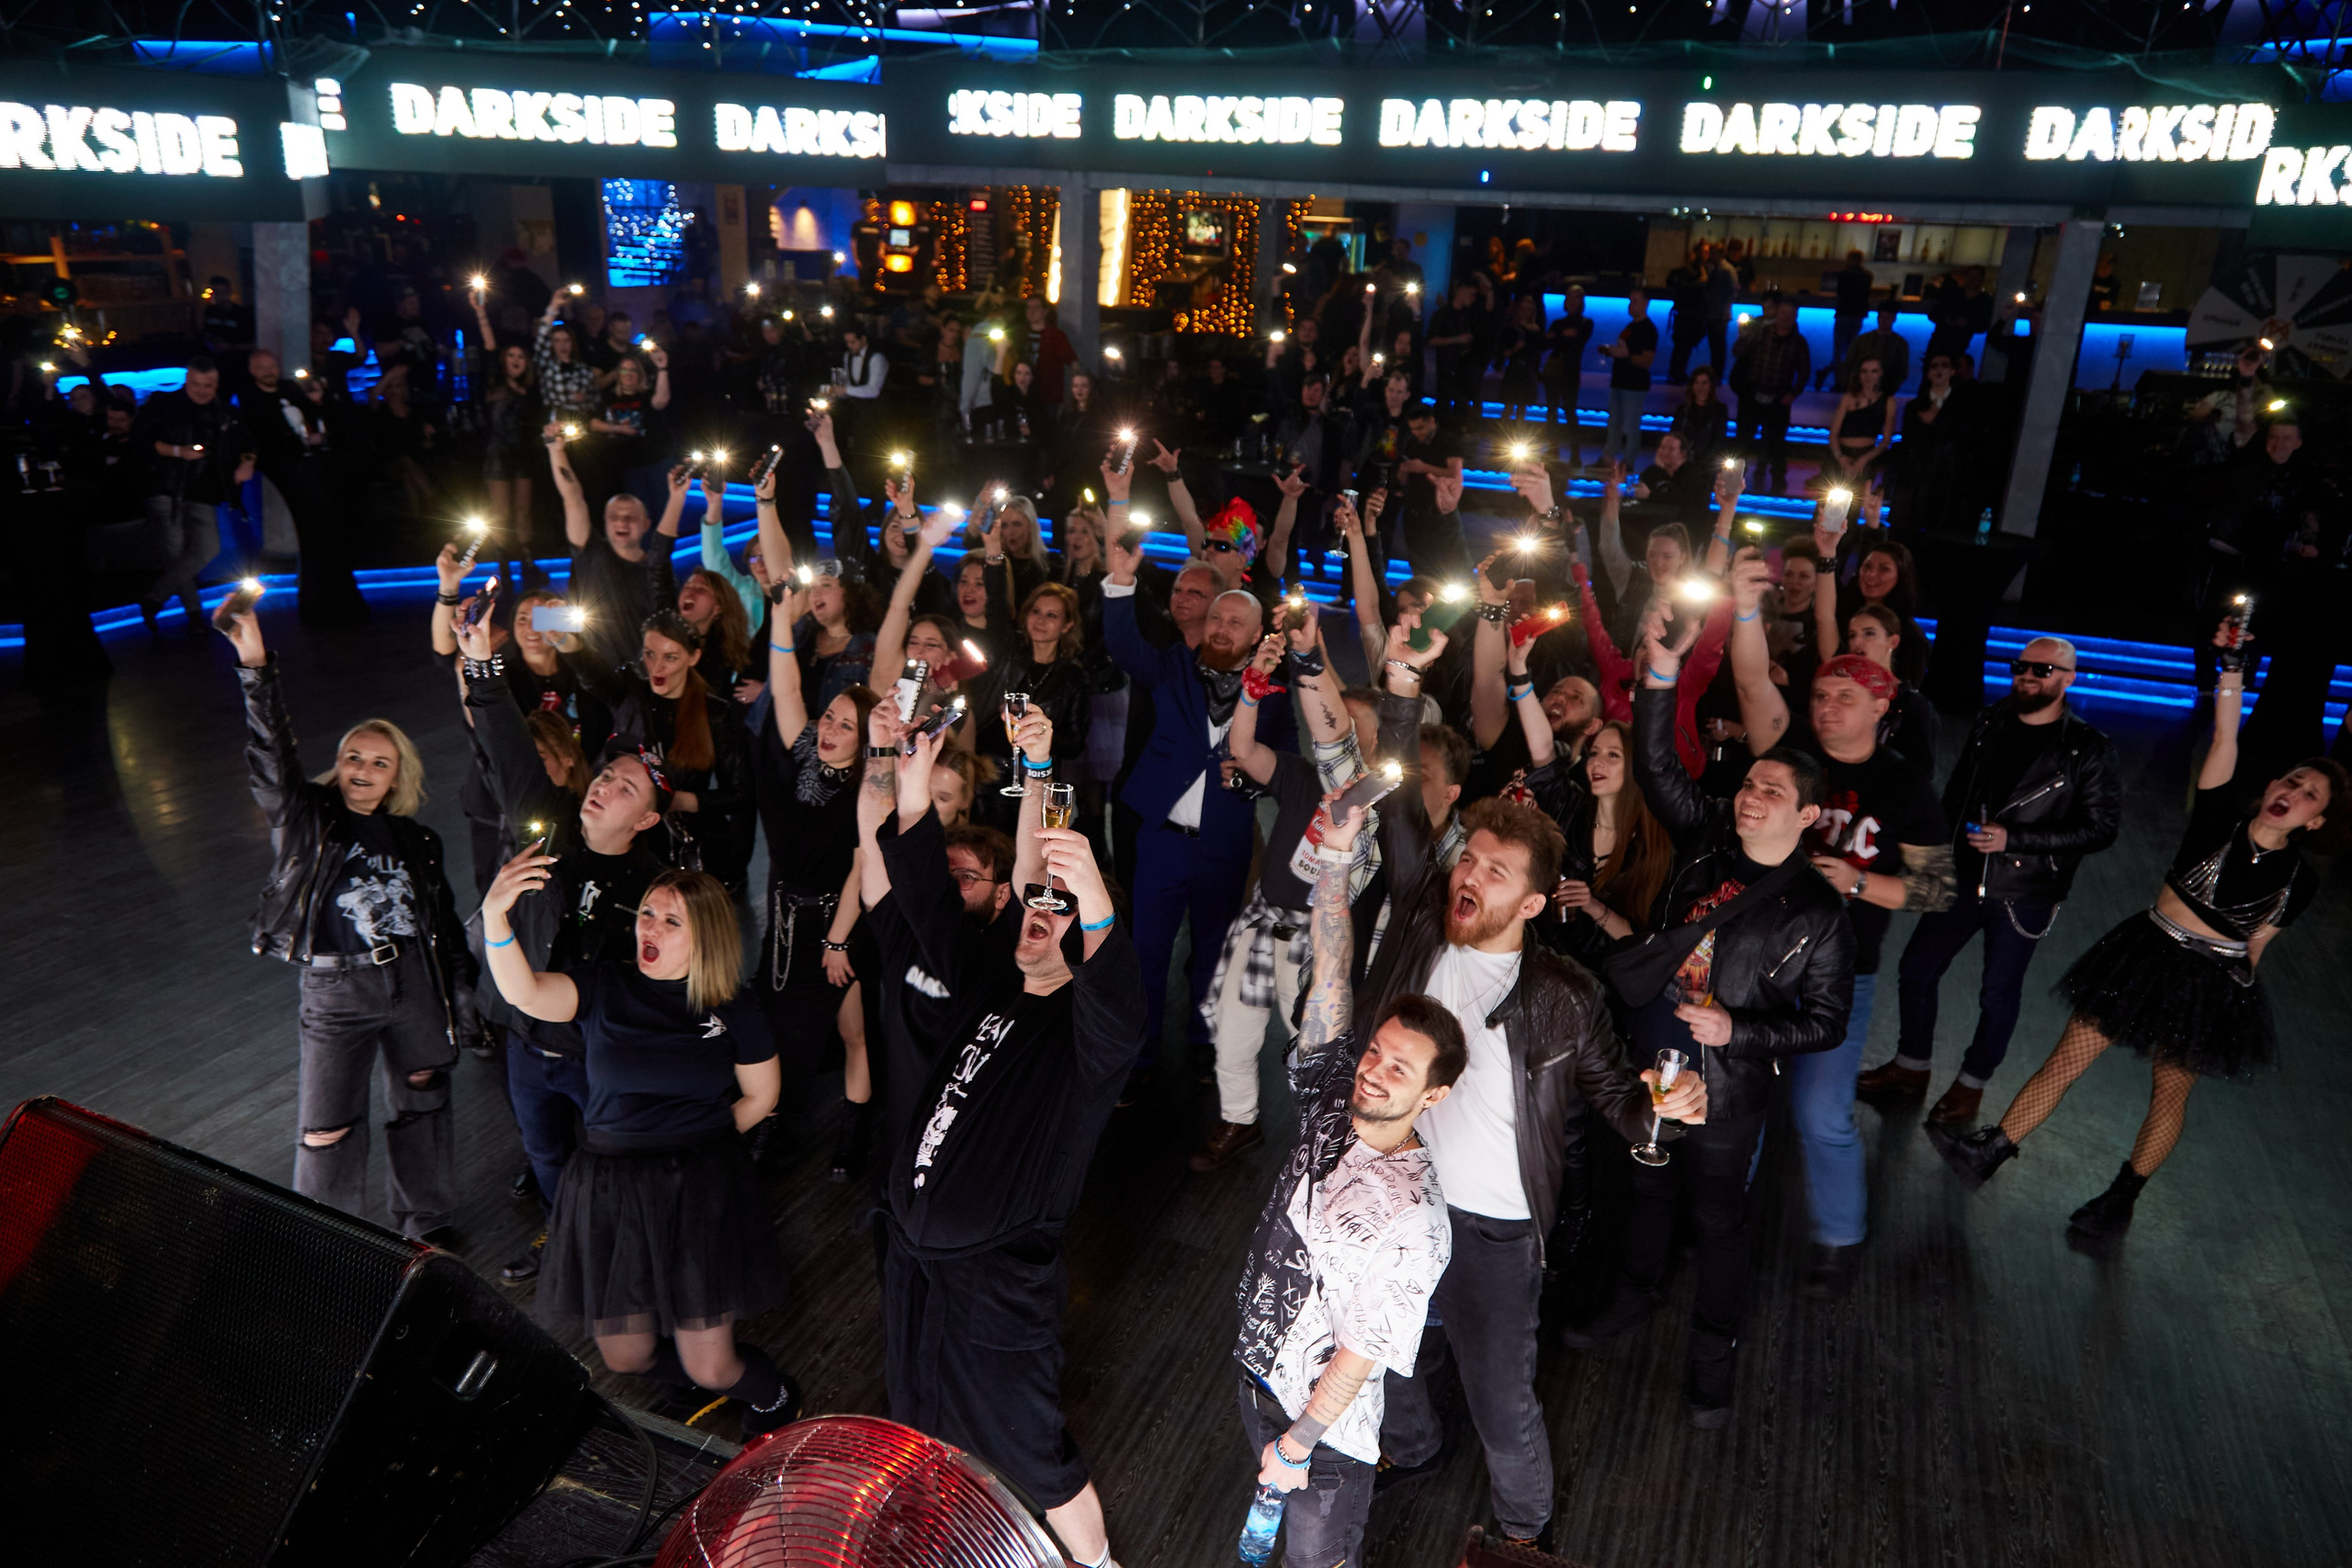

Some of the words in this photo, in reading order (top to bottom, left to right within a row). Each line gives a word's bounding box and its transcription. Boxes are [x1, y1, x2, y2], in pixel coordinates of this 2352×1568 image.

[390, 82, 678, 148] DARKSIDE
[1114, 94, 1345, 145] DARKSIDE
[1378, 98, 1642, 152] DARKSIDE
[1679, 102, 1982, 159] DARKSIDE
[1302, 850, 1321, 866] TOMA
